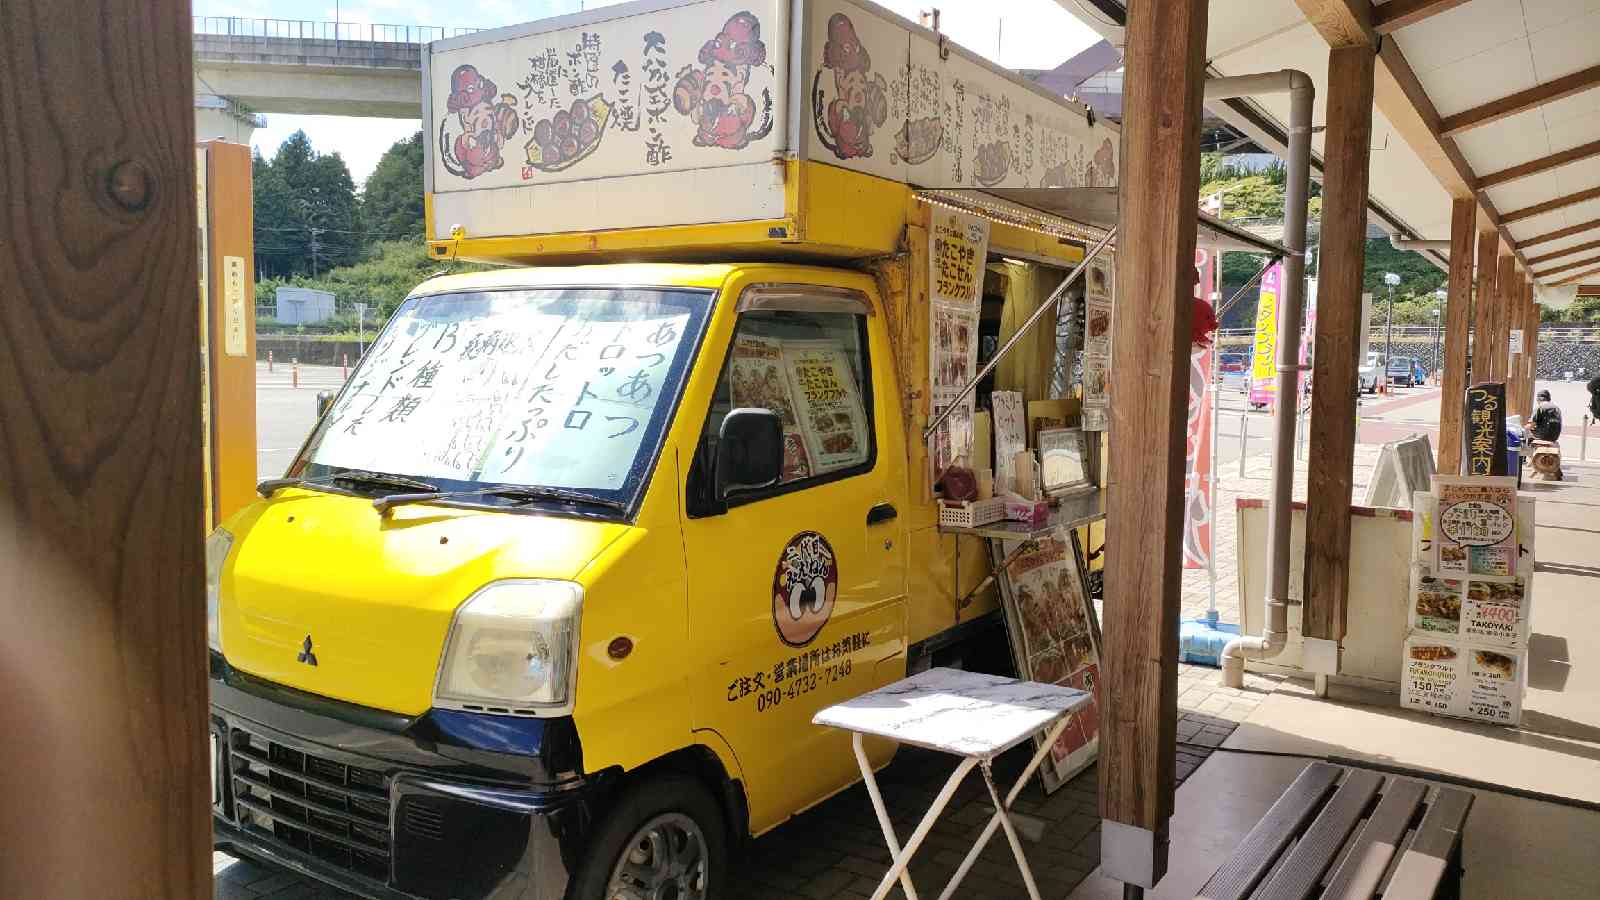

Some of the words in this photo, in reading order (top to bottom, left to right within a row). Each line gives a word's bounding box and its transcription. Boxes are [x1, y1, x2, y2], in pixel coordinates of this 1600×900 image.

[563, 324, 628, 430] トロットロ
[607, 322, 677, 439] あつあつ
[1471, 620, 1513, 632] TAKOYAKI
[757, 658, 852, 713] 090-4732-7248
[1413, 681, 1432, 691] 150
[1477, 706, 1496, 717] 250
